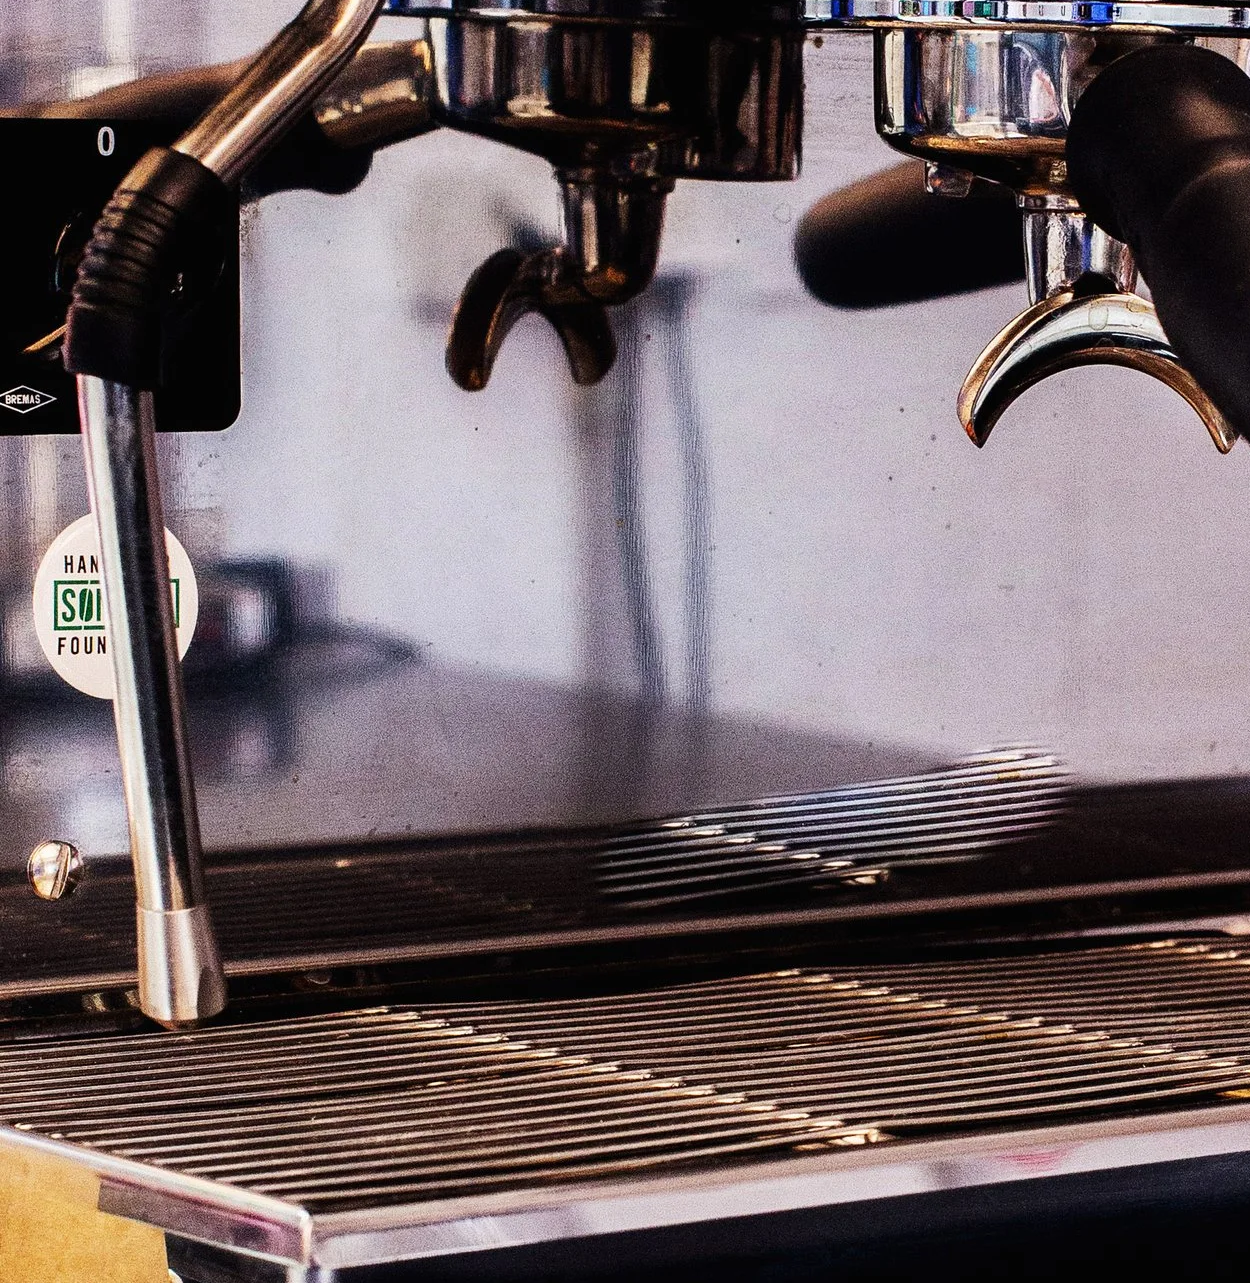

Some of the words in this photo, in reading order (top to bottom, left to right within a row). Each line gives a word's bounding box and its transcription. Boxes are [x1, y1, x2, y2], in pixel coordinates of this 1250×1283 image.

[5, 394, 41, 405] BREMAS
[64, 555, 100, 574] HAN
[58, 636, 107, 656] FOUN
